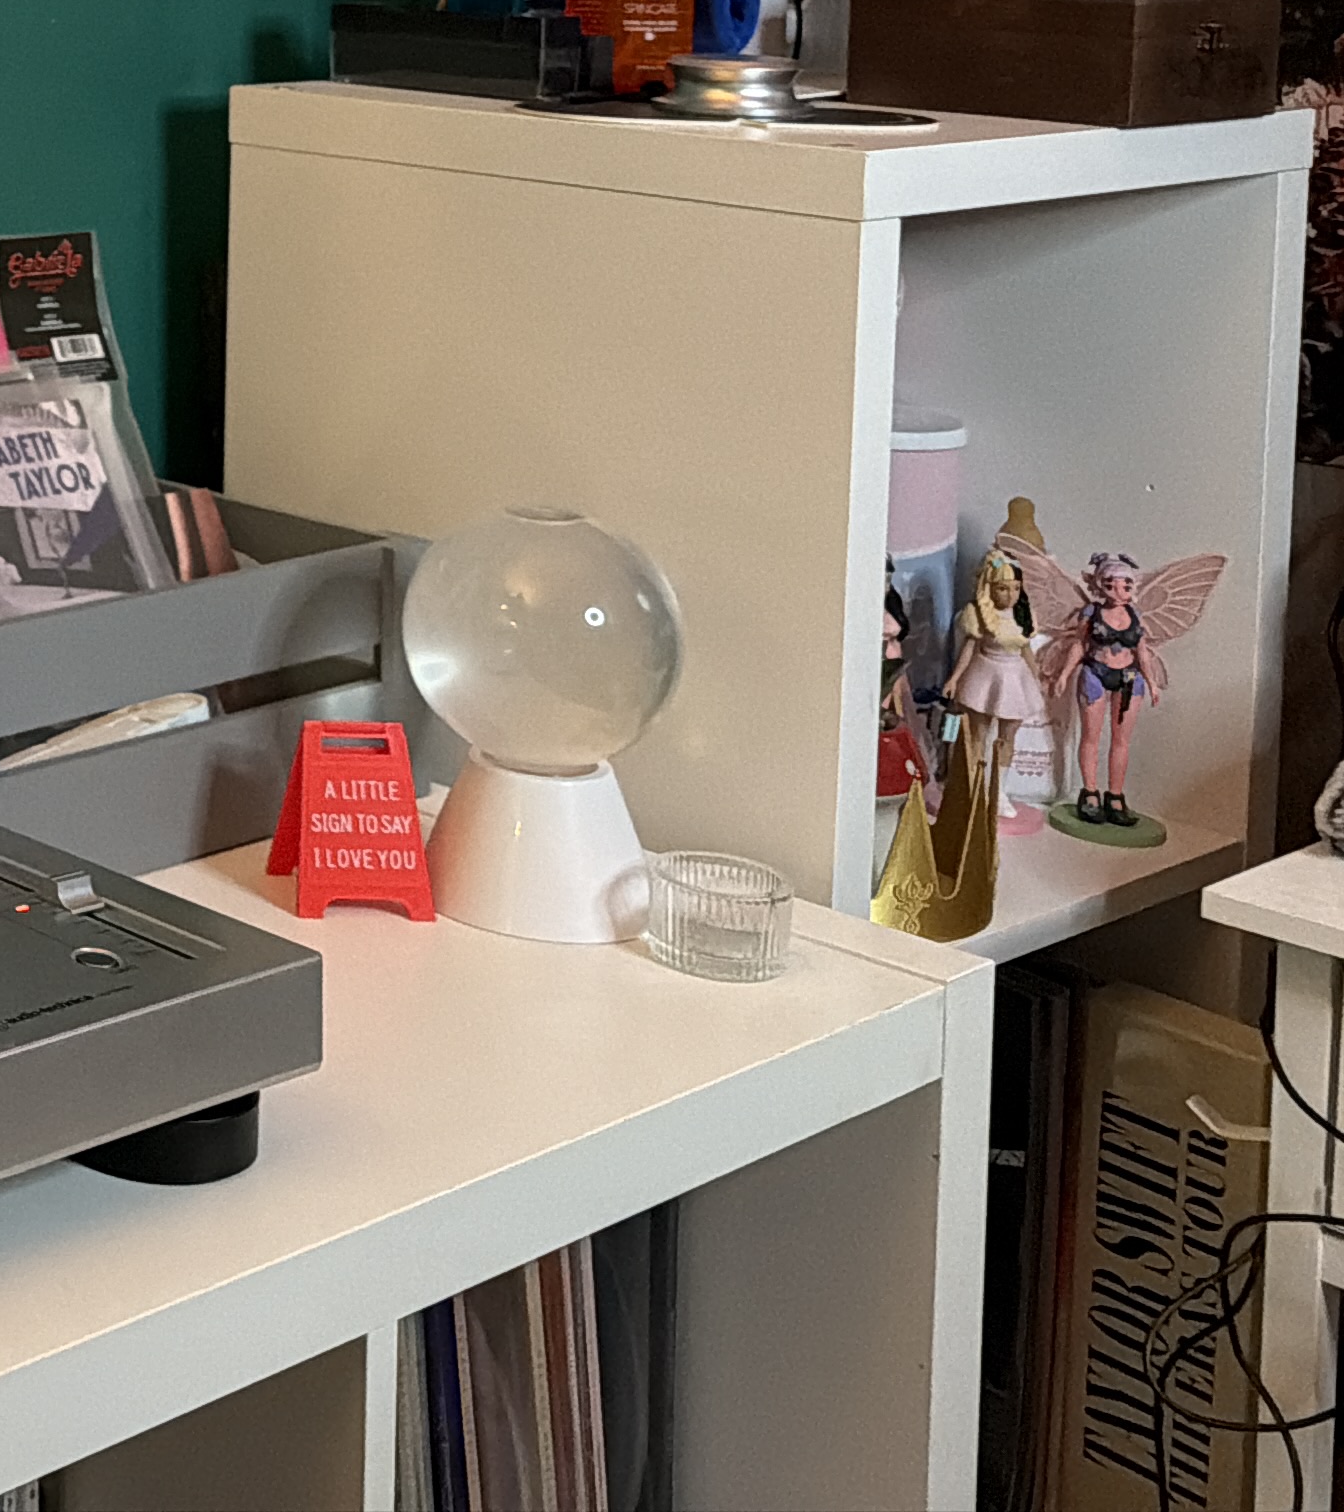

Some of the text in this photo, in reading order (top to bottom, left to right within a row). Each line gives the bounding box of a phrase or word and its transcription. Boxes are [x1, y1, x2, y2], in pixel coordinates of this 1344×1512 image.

[9, 461, 97, 502] TAYLOR
[324, 779, 401, 802] A LITTLE
[311, 812, 413, 835] SIGN TO SAY
[313, 847, 417, 871] I LOVE YOU
[1180, 1128, 1230, 1260] TOUR
[1083, 1090, 1183, 1487] TAYLOR SWIFT
